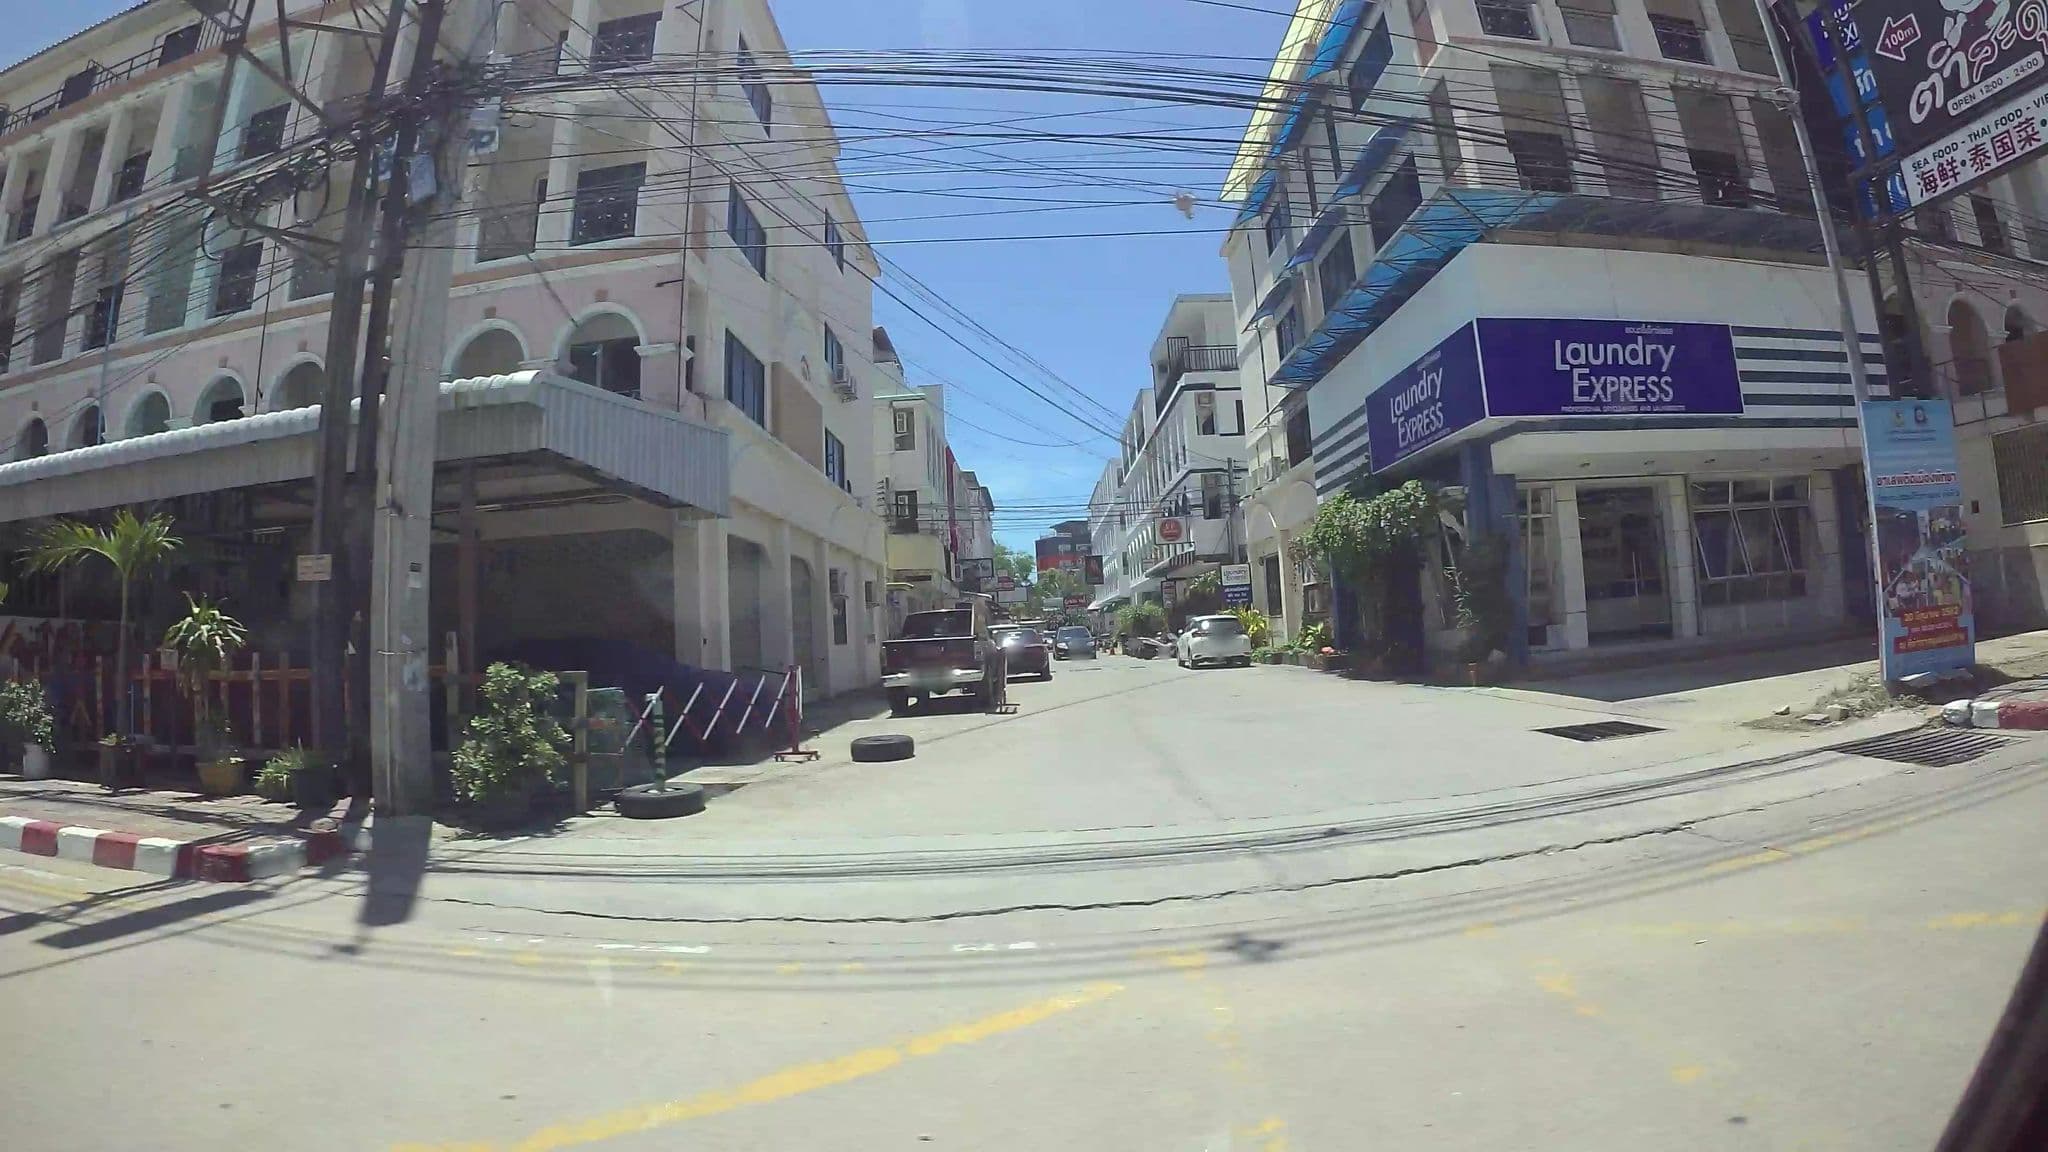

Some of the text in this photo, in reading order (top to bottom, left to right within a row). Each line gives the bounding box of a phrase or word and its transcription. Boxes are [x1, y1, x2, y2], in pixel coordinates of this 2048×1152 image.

[1884, 27, 1915, 48] 100m
[1951, 93, 1977, 111] OPEN
[2013, 57, 2040, 76] 24:00
[1911, 158, 1930, 172] SEA
[1932, 142, 1959, 162] FOOD
[1968, 125, 1992, 143] THAI
[1994, 109, 2023, 130] FOOD
[1555, 335, 1676, 373] Laundry
[1390, 367, 1443, 424] Laundry
[1572, 367, 1674, 403] EXPRESS
[1397, 401, 1444, 448] EXPRESS
